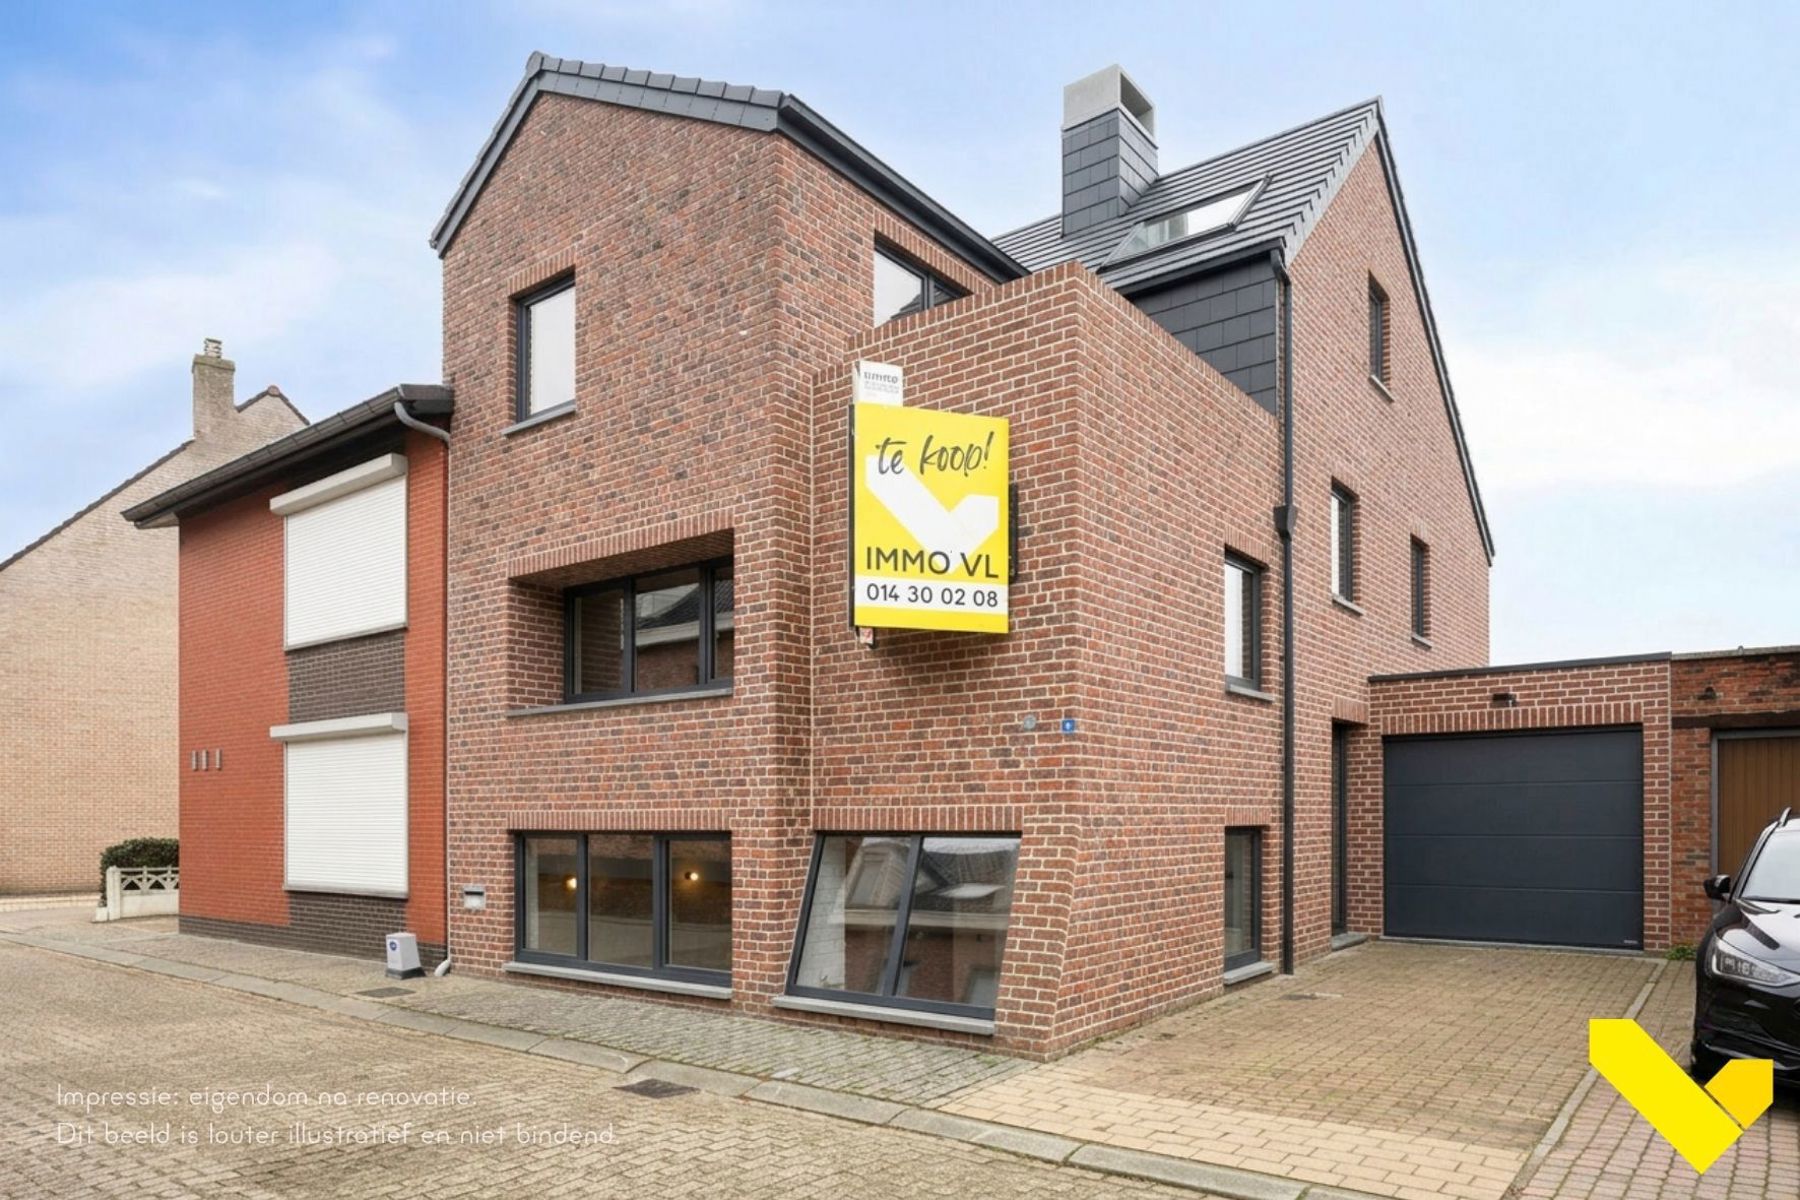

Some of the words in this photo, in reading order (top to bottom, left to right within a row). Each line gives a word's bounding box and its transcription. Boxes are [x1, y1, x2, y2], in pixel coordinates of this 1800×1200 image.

[875, 437, 907, 475] te
[919, 431, 995, 477] koop!
[866, 546, 951, 575] IMMO
[960, 552, 999, 579] VL
[866, 583, 900, 601] 014
[908, 585, 933, 604] 30
[941, 587, 966, 606] 02
[973, 590, 998, 608] 08
